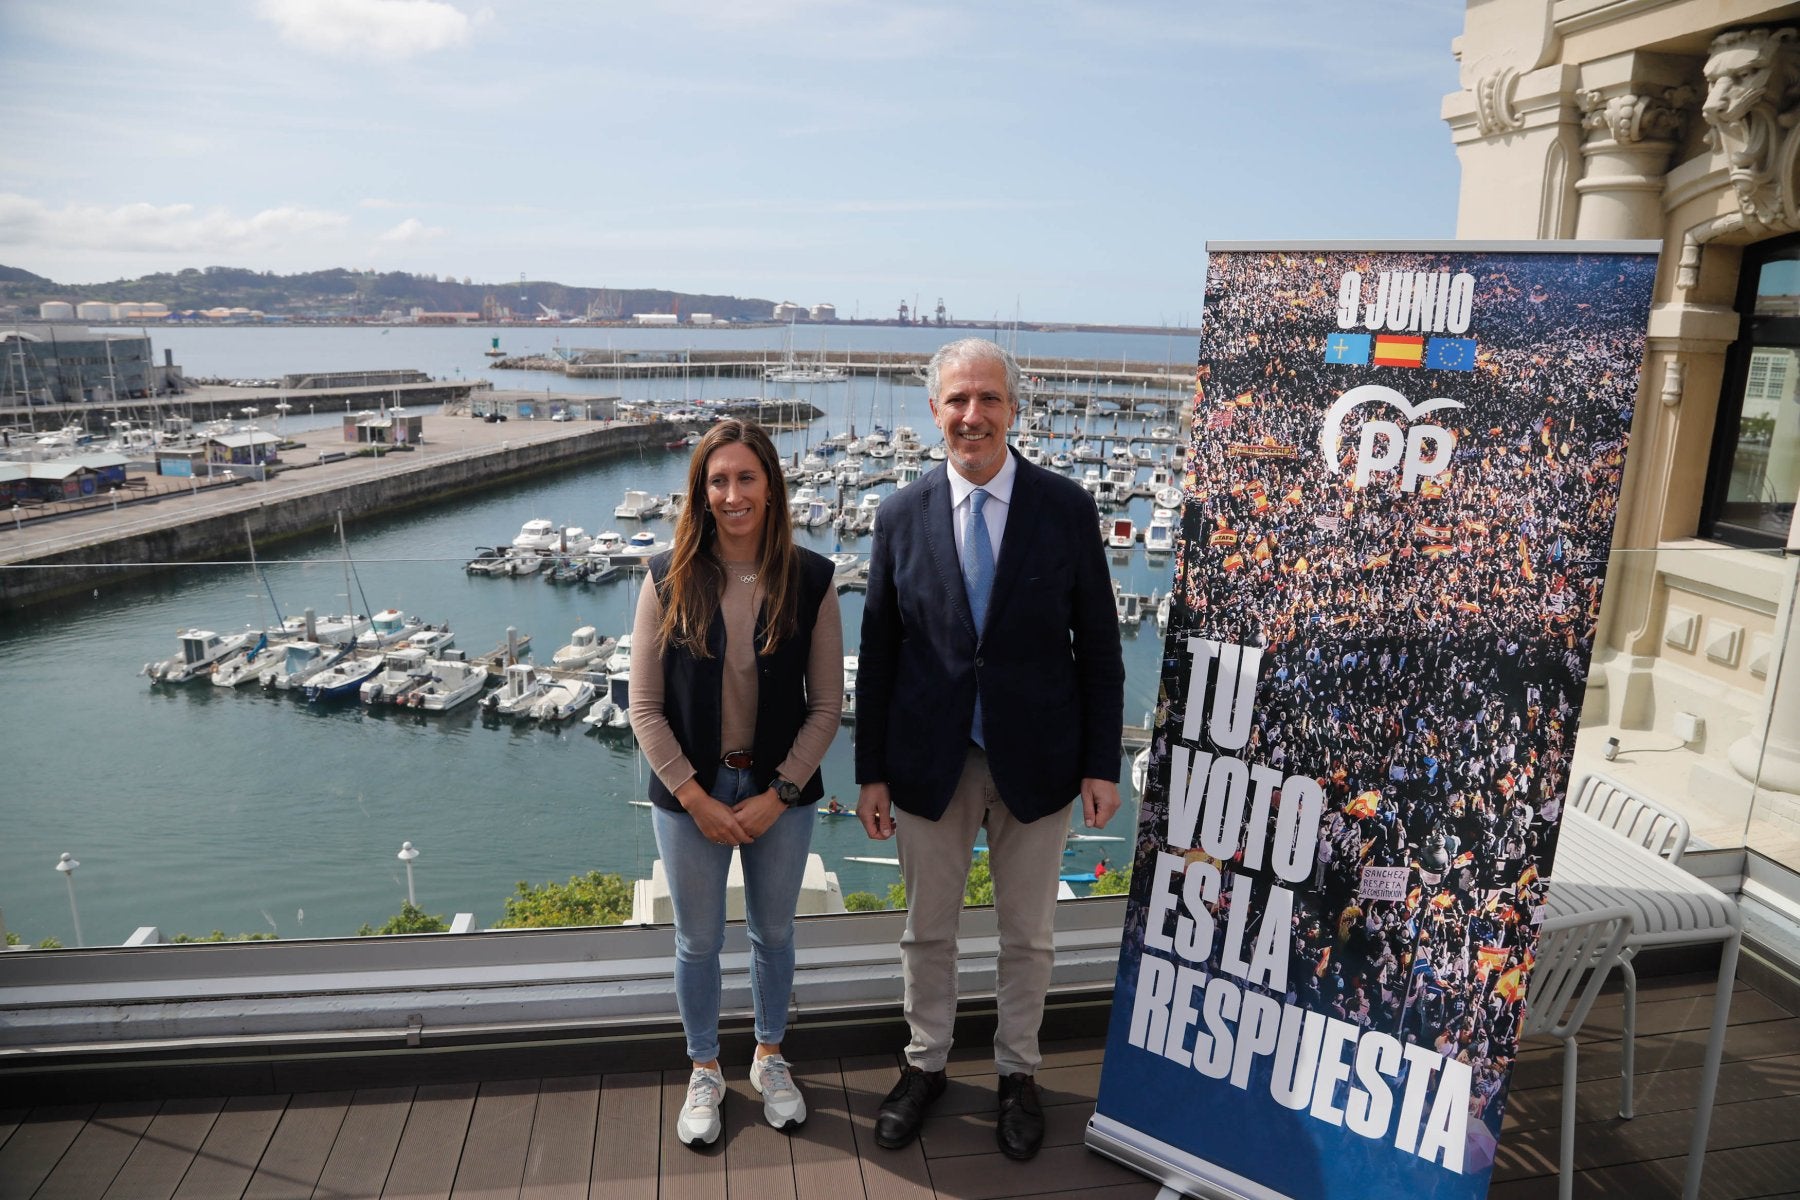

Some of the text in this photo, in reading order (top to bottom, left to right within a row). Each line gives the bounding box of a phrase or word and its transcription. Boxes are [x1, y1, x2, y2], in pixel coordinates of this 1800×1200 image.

[1337, 271, 1475, 334] 9 JUNIO
[1183, 637, 1262, 749] TU
[1166, 745, 1322, 883] VOTO
[1144, 851, 1294, 993] ES LA
[1363, 879, 1402, 889] RESPETA
[1128, 953, 1473, 1174] RESPUESTA
